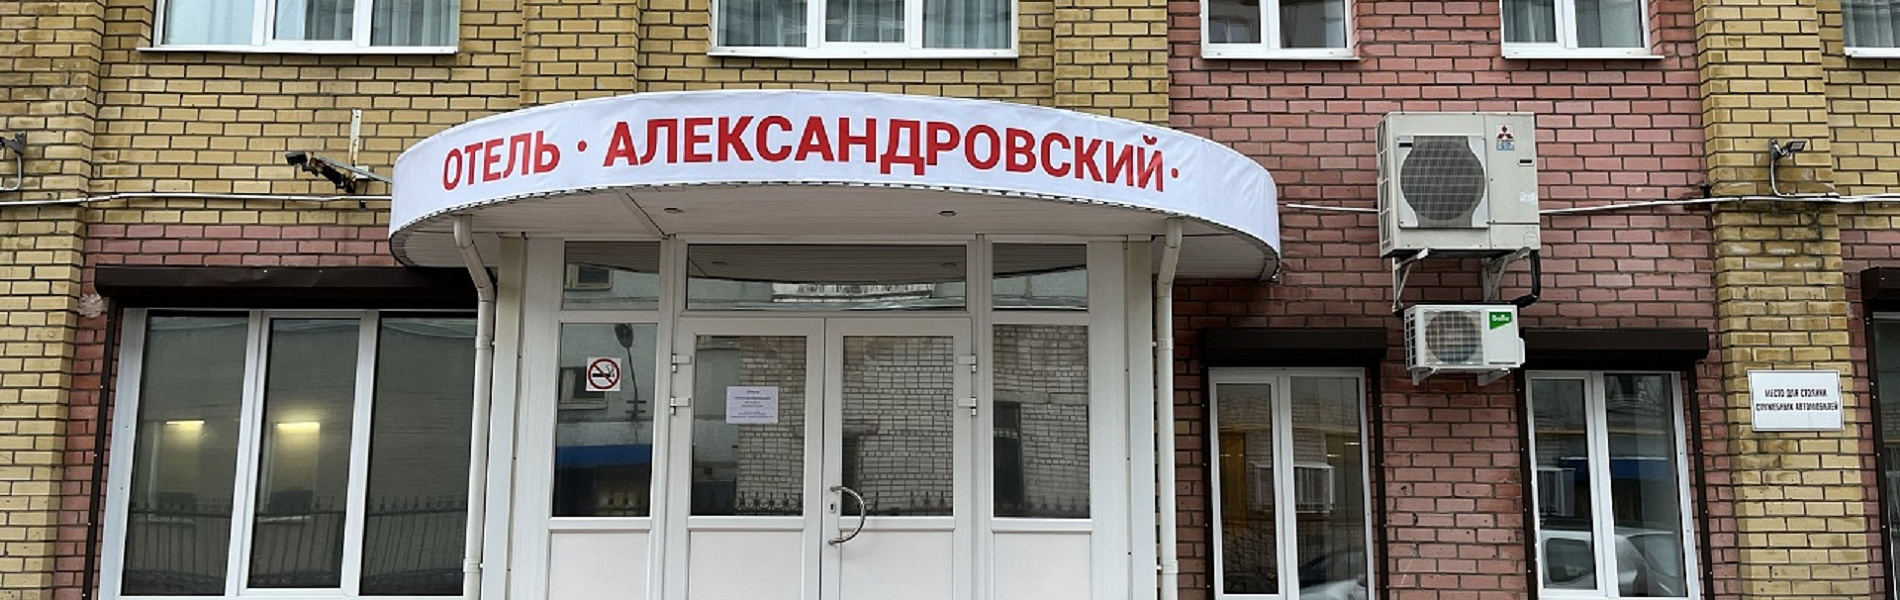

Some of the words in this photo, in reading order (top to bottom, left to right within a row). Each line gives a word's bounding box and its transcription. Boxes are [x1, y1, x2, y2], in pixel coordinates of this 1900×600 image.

[442, 130, 560, 190] ОТЕЛЬ
[603, 116, 1164, 192] АЛЕКСАНДРОВСКИЙ
[1764, 388, 1785, 398] МЕСТО
[1786, 388, 1799, 398] ДЛЯ
[1755, 402, 1794, 411] СЛУЖЕБНЫХ
[1795, 401, 1838, 411] АВТОМОБИЛЕЙ
